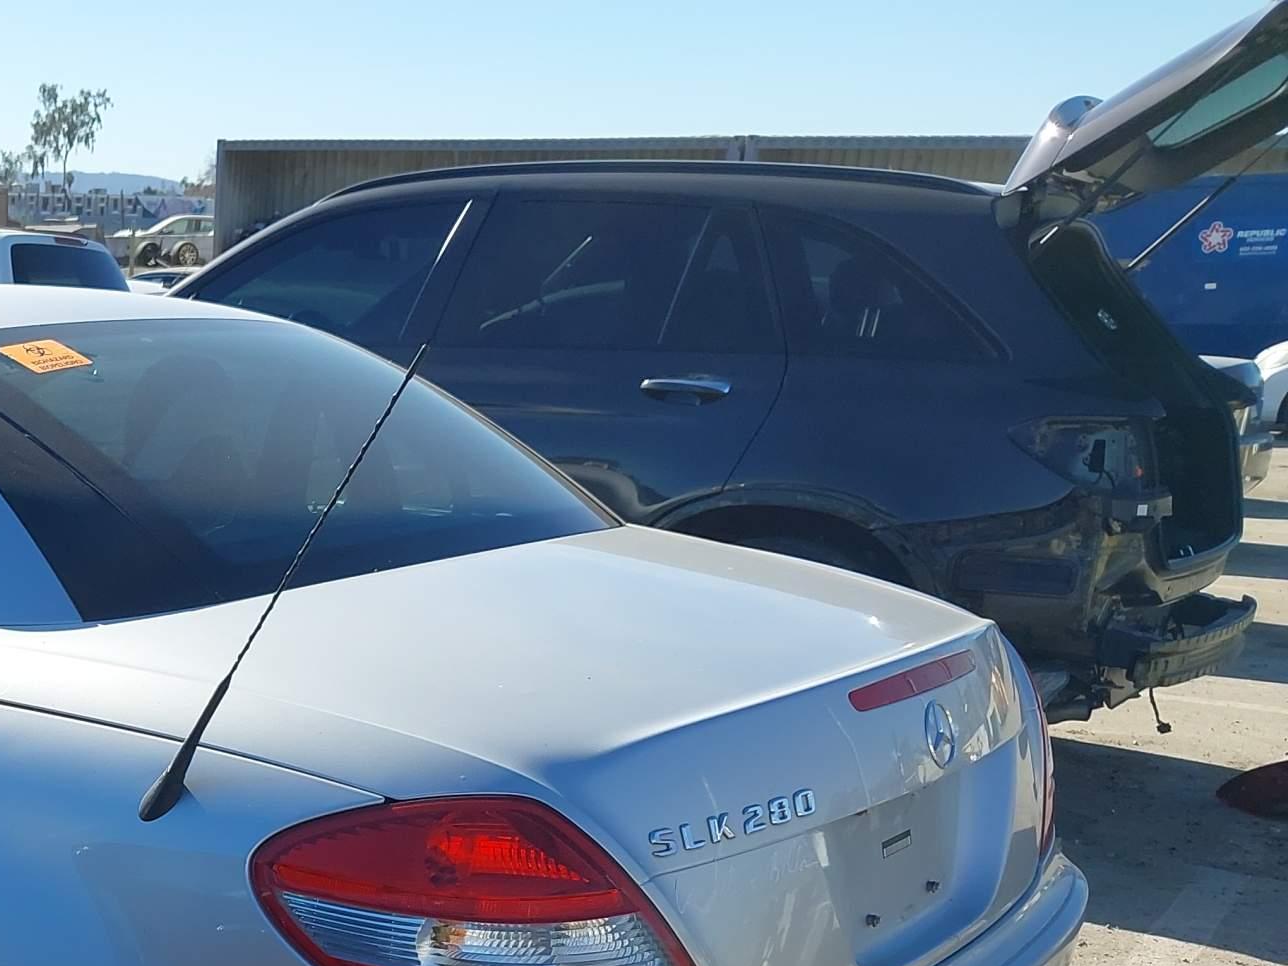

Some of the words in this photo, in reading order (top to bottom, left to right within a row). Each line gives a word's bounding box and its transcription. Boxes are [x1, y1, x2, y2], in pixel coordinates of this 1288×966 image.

[1237, 228, 1287, 239] REPUBLIC
[648, 810, 736, 858] SLK
[741, 788, 817, 835] 280
